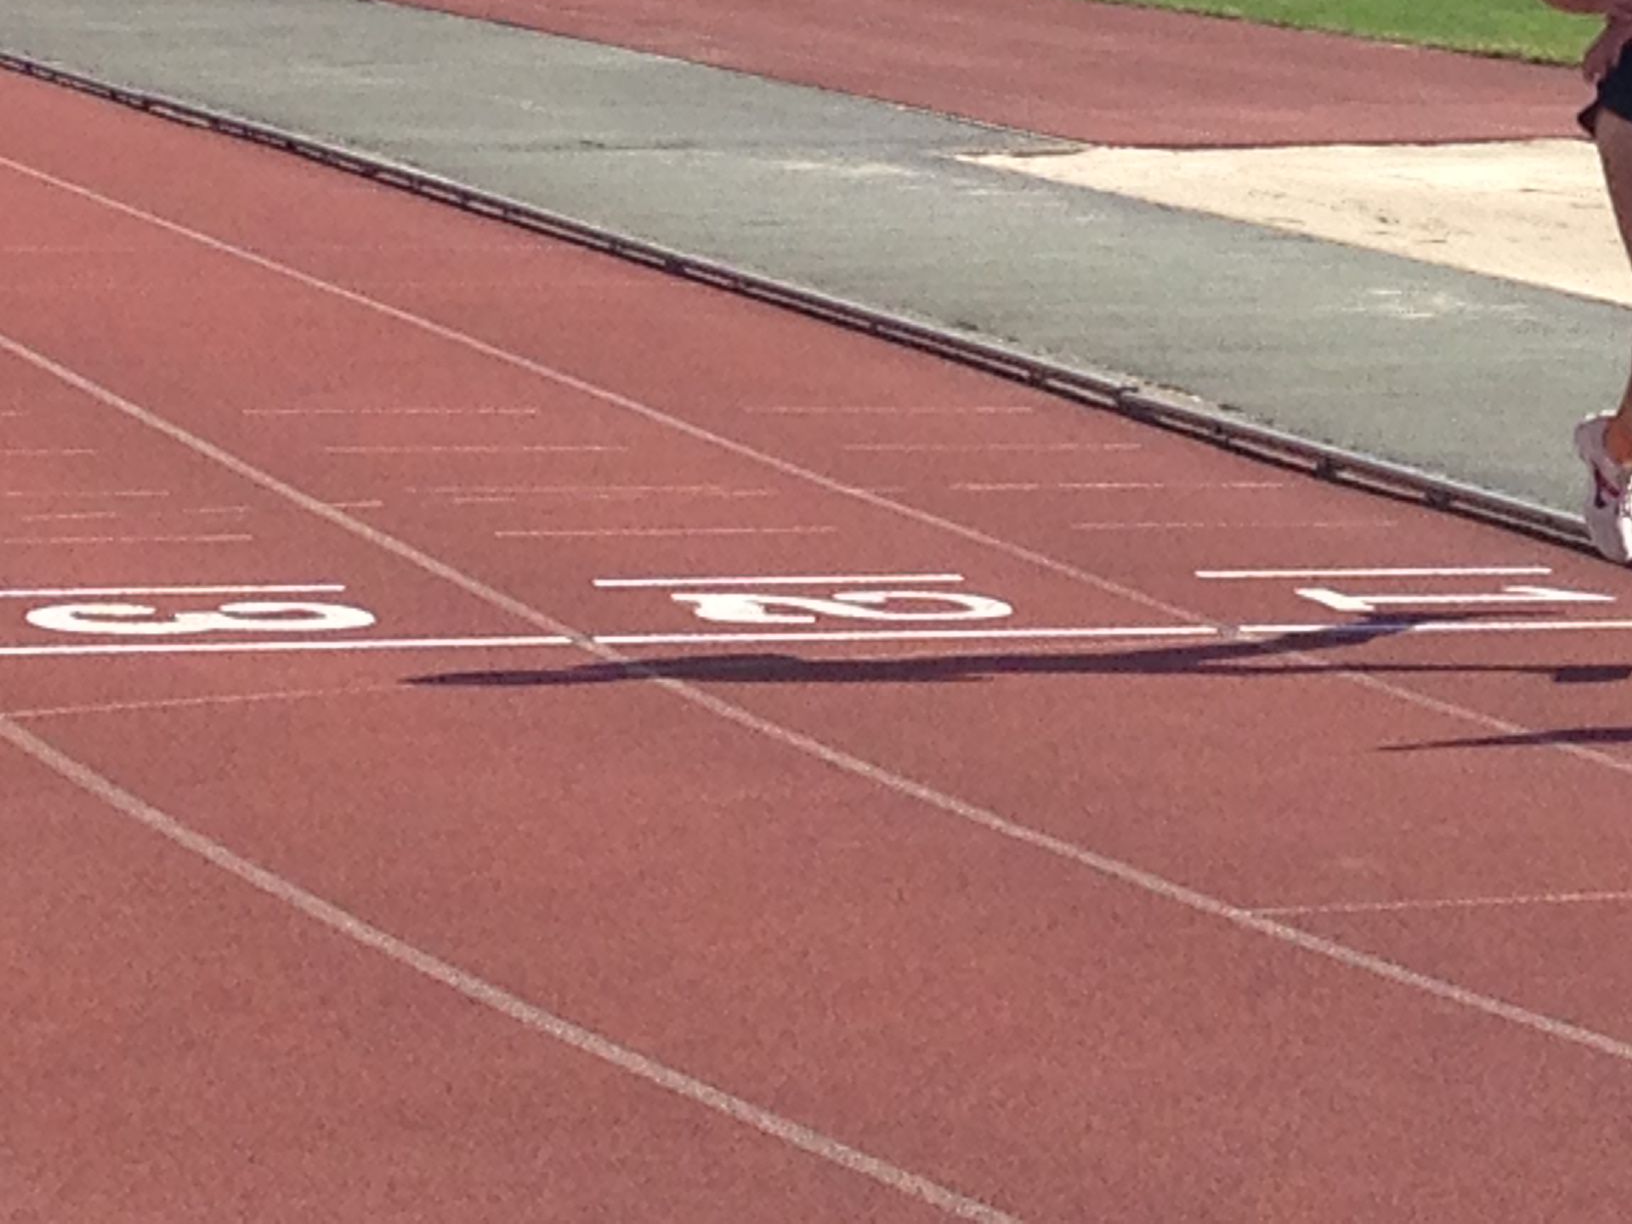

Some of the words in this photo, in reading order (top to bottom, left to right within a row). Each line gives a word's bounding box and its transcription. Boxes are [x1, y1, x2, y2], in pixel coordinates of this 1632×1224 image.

[671, 590, 1012, 623] 2
[1294, 585, 1616, 612] 1
[25, 602, 376, 634] 3
